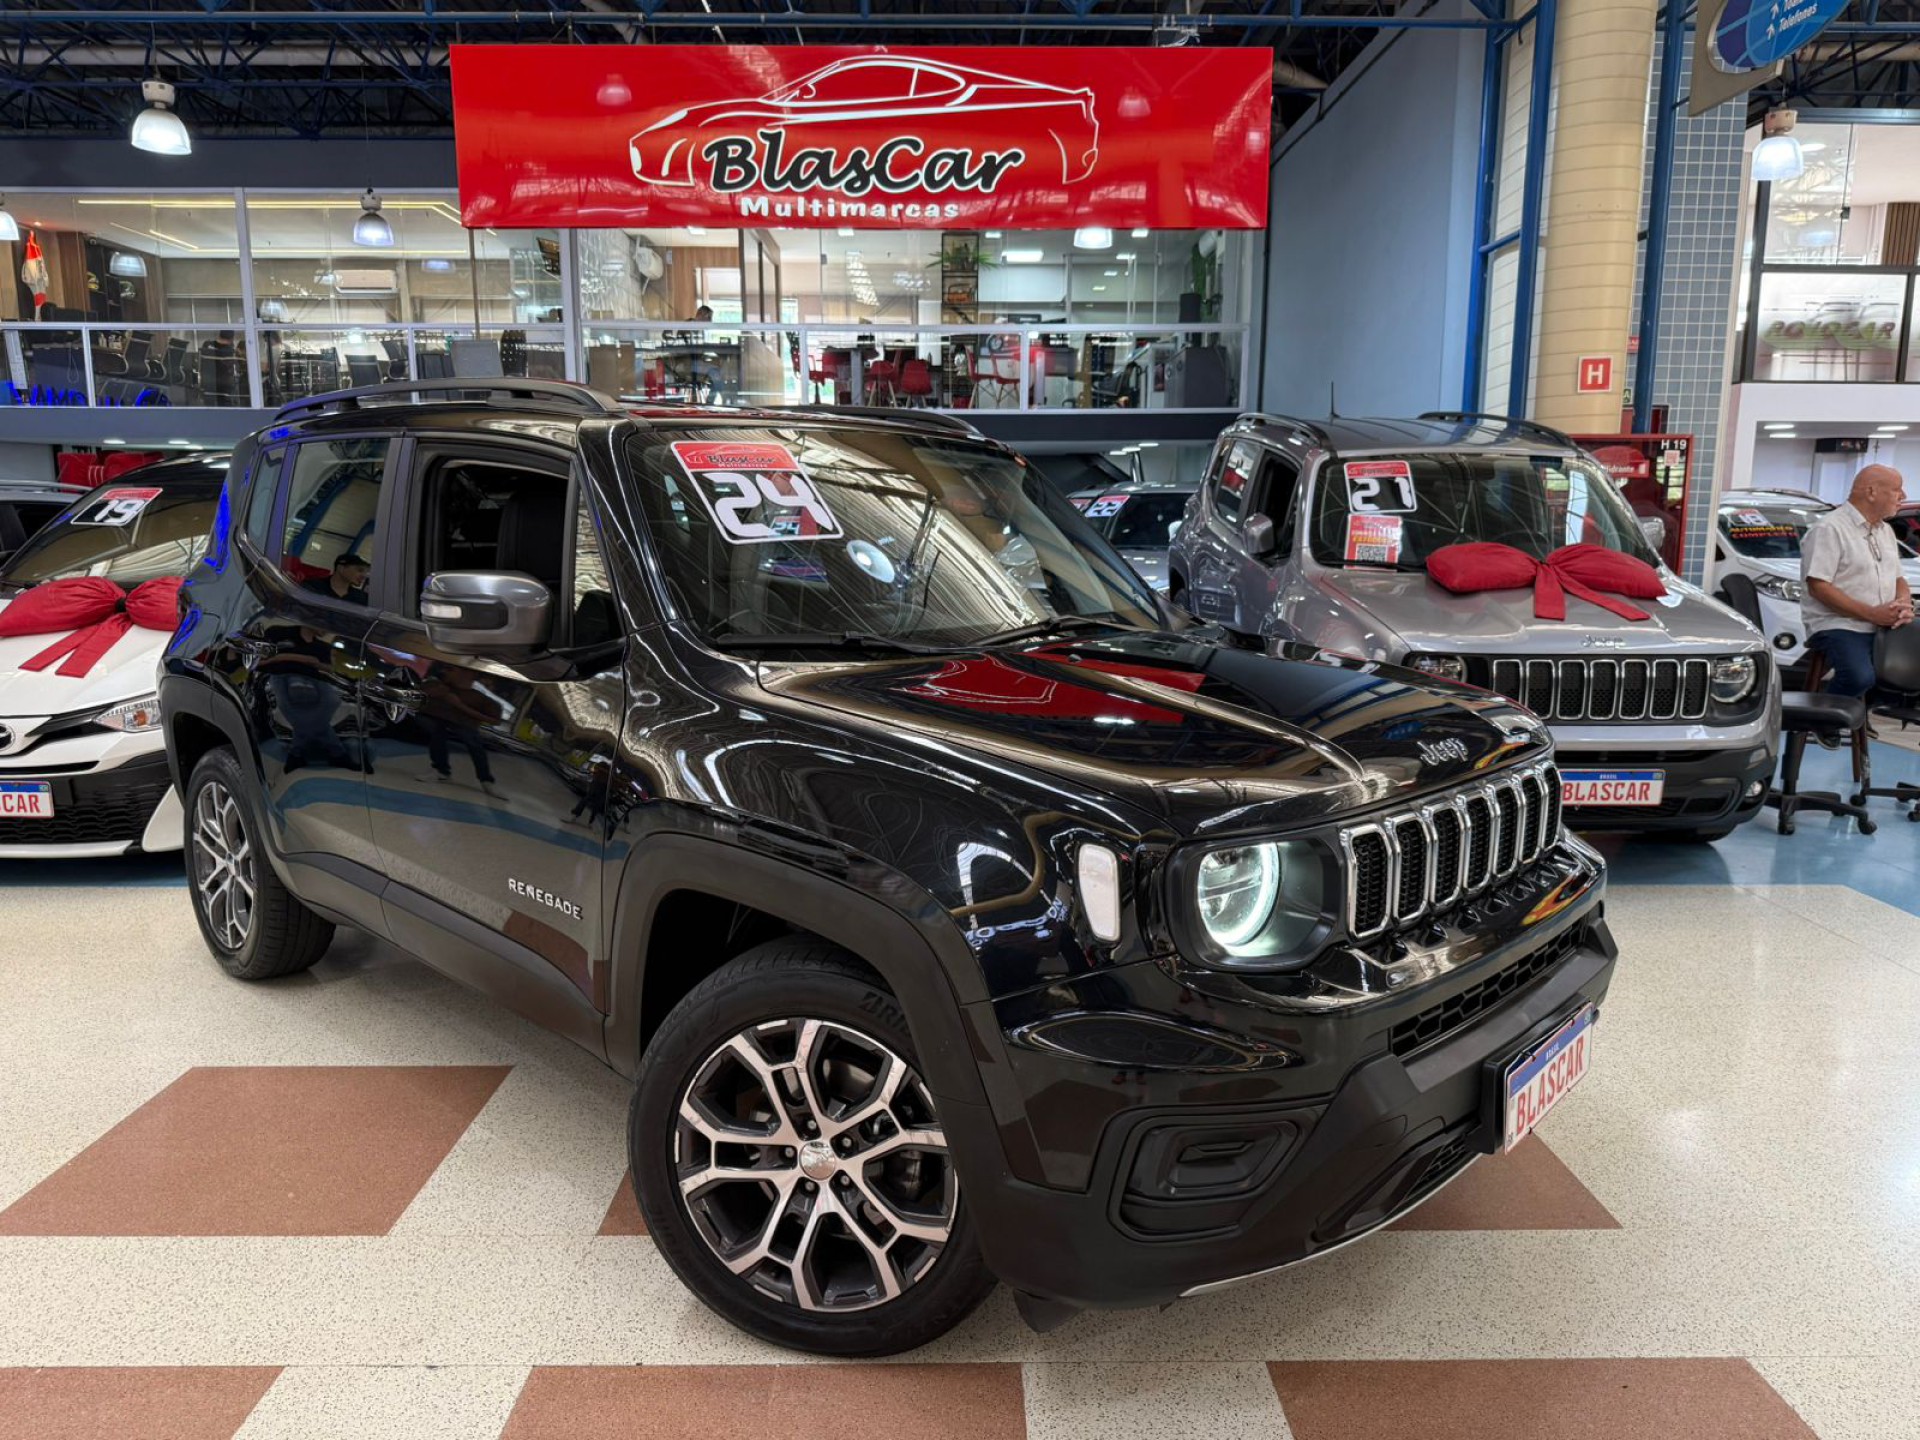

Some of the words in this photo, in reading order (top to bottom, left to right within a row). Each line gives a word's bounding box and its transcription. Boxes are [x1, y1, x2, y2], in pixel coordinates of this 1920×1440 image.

[1779, 3, 1818, 32] Telefones
[703, 128, 1025, 195] BlasCar
[740, 197, 961, 218] Multimarcas
[1586, 363, 1604, 385] H
[1673, 438, 1687, 450] 19
[702, 473, 833, 537] 24
[1351, 477, 1413, 511] 21
[94, 499, 145, 523] 19
[1416, 738, 1469, 766] Jeep
[0, 794, 41, 813] CAR
[1562, 782, 1651, 801] BLASCAR
[508, 878, 583, 920] RENEGADE
[1516, 1036, 1584, 1135] BLASCAR
